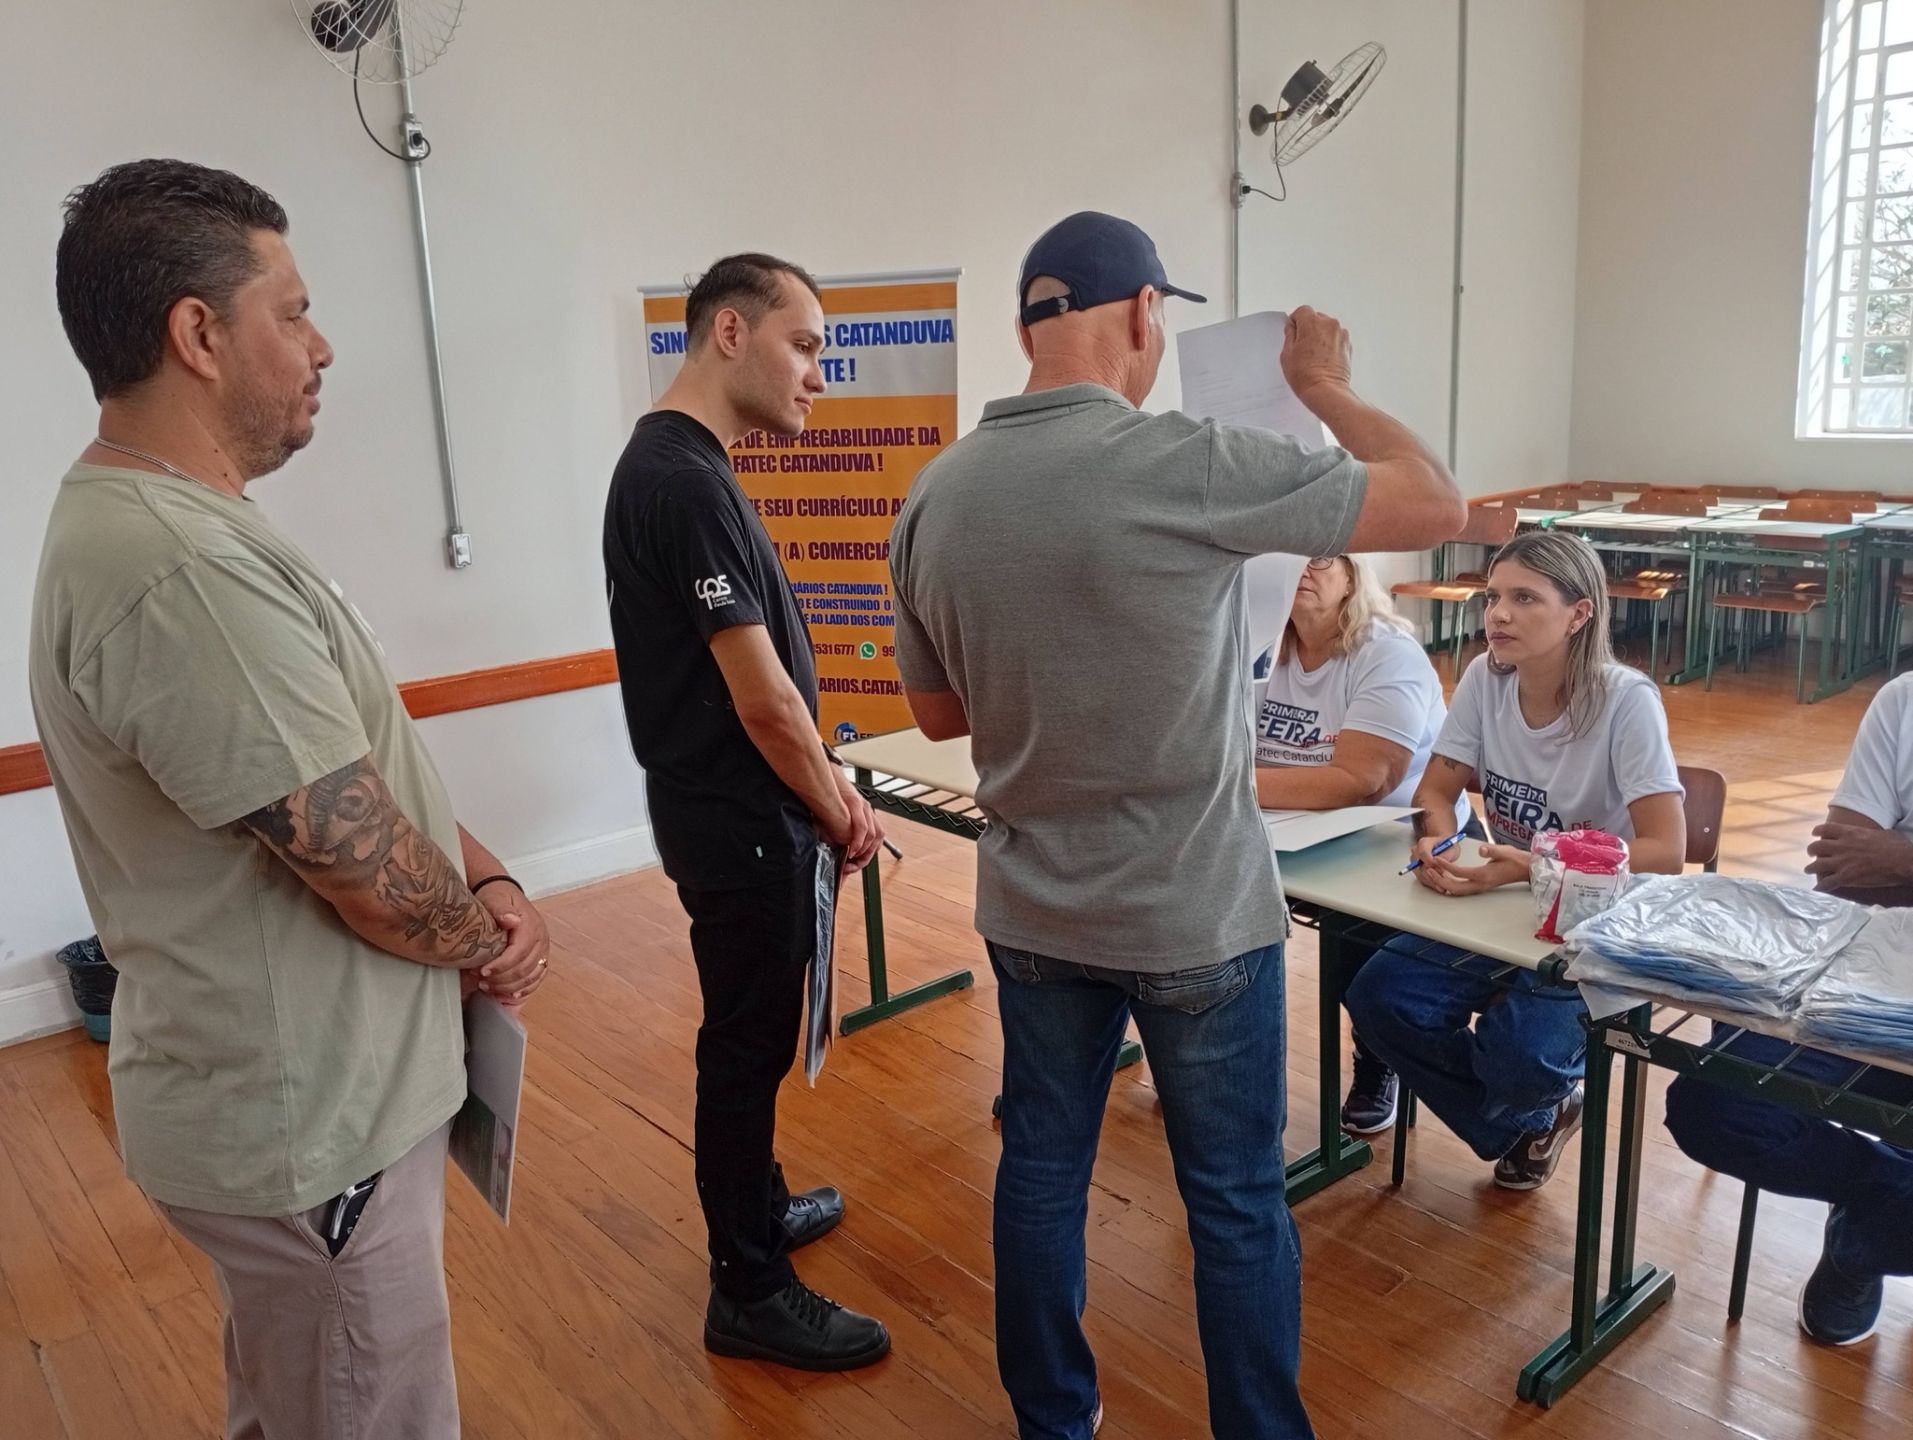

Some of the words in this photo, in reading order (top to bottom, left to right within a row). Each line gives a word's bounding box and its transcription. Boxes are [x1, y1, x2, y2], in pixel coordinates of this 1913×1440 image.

[650, 331, 688, 355] SIN
[835, 319, 955, 347] CATANDUVA
[818, 358, 846, 382] TE
[917, 427, 941, 446] DA
[733, 455, 777, 474] FATEC
[780, 453, 875, 474] CATANDUVA
[764, 498, 794, 517] SEU
[796, 495, 888, 517] CURRÍCULO
[784, 541, 805, 562] (A)
[827, 583, 883, 596] CATANDUVA
[813, 599, 880, 611] CONSTRUINDO
[810, 613, 824, 625] AO
[825, 613, 849, 625] LADO
[851, 615, 870, 626] DOS
[1483, 785, 1565, 832] FEIRA
